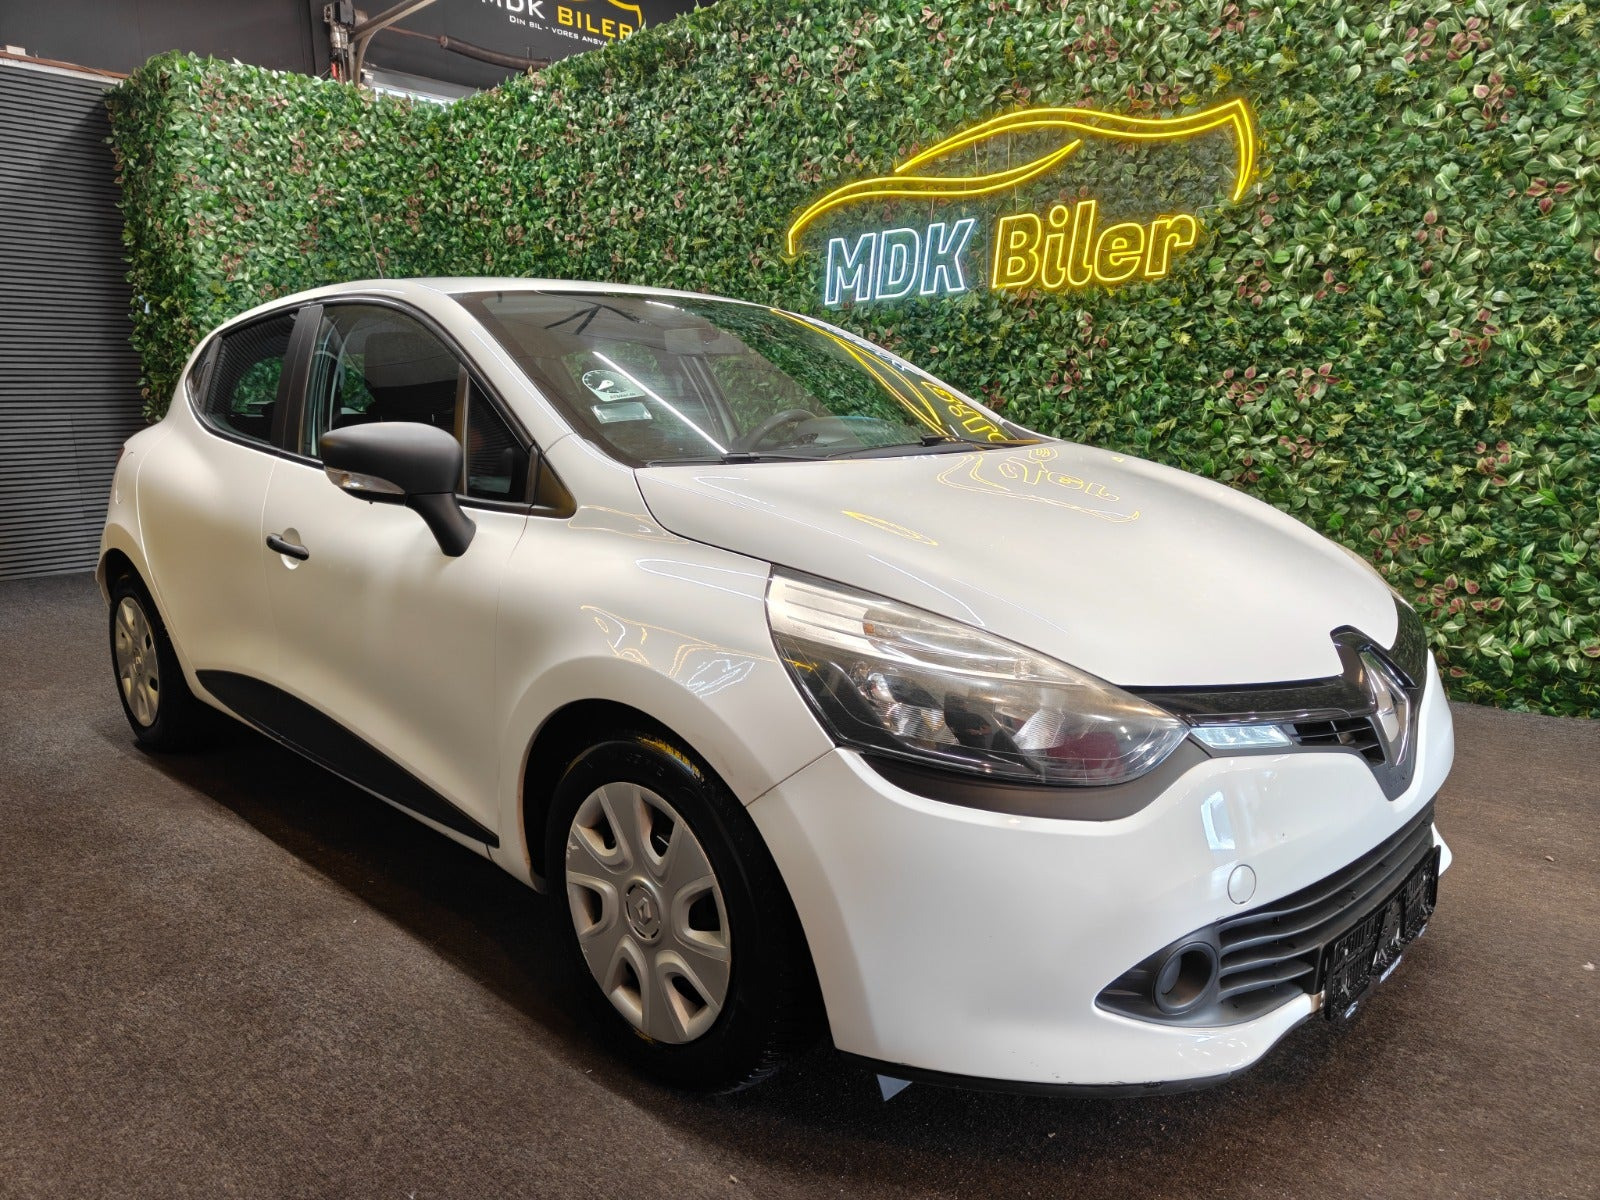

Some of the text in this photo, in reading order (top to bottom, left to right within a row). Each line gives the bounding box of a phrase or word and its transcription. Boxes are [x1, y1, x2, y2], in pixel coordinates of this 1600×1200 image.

[509, 15, 526, 26] DIN
[529, 21, 543, 31] BIL
[551, 27, 579, 40] VORES
[557, 5, 633, 40] BILER
[823, 200, 1198, 306] MDK Biler
